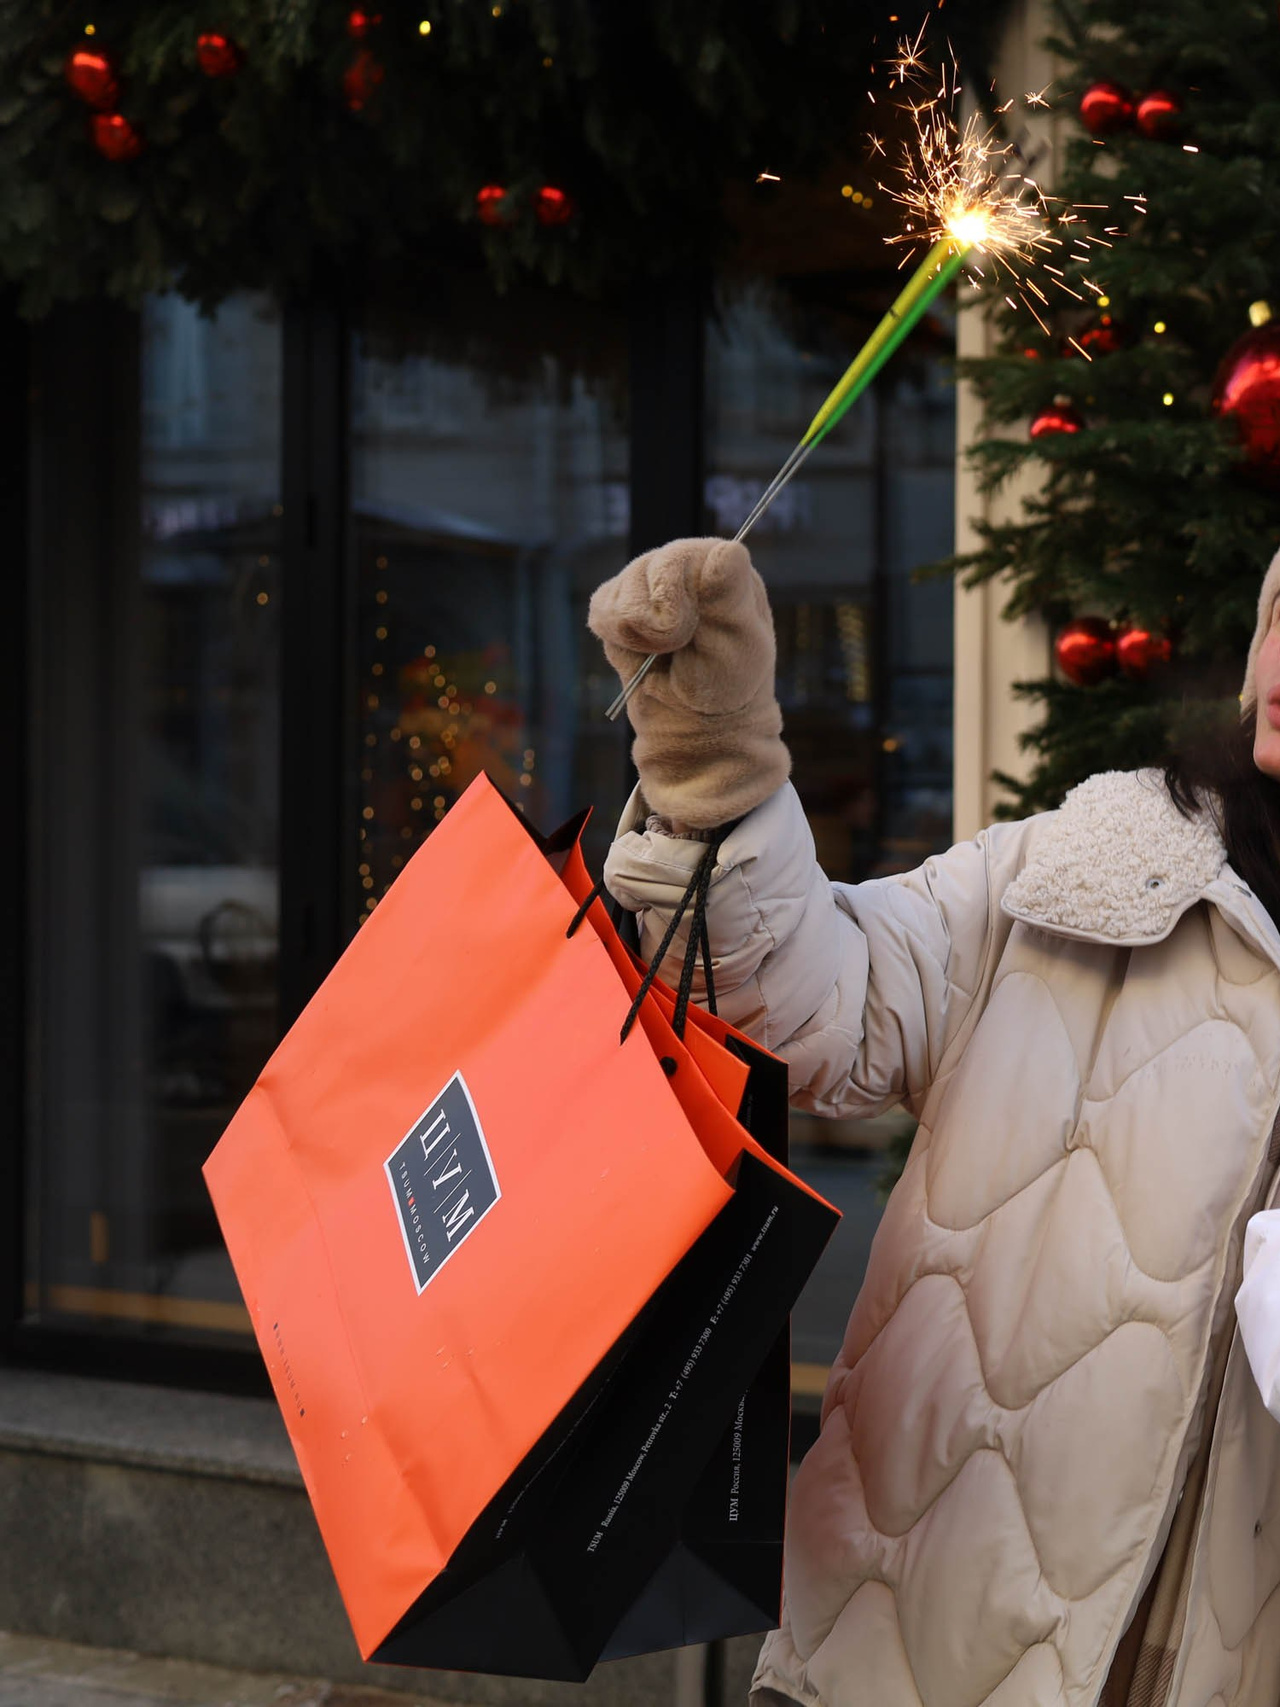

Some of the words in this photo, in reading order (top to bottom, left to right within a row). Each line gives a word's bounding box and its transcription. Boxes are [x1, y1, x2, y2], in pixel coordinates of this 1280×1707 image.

[398, 1162, 413, 1200] TSUM
[409, 1204, 431, 1264] MOSCOW
[587, 1531, 604, 1552] TSUM
[600, 1504, 620, 1528] Russia,
[613, 1480, 632, 1505] 125009
[641, 1422, 663, 1453] Petrovka
[675, 1379, 684, 1391] +7
[680, 1358, 697, 1379] (495)
[691, 1344, 703, 1360] 933
[698, 1327, 712, 1346] 7300
[716, 1304, 724, 1315] +7
[720, 1284, 737, 1305] (495)
[731, 1271, 743, 1285] 933
[738, 1253, 753, 1272] 7301
[751, 1205, 779, 1251] www.tsum.ru
[732, 1432, 742, 1461] 125009
[729, 1497, 740, 1522] ЦУМ
